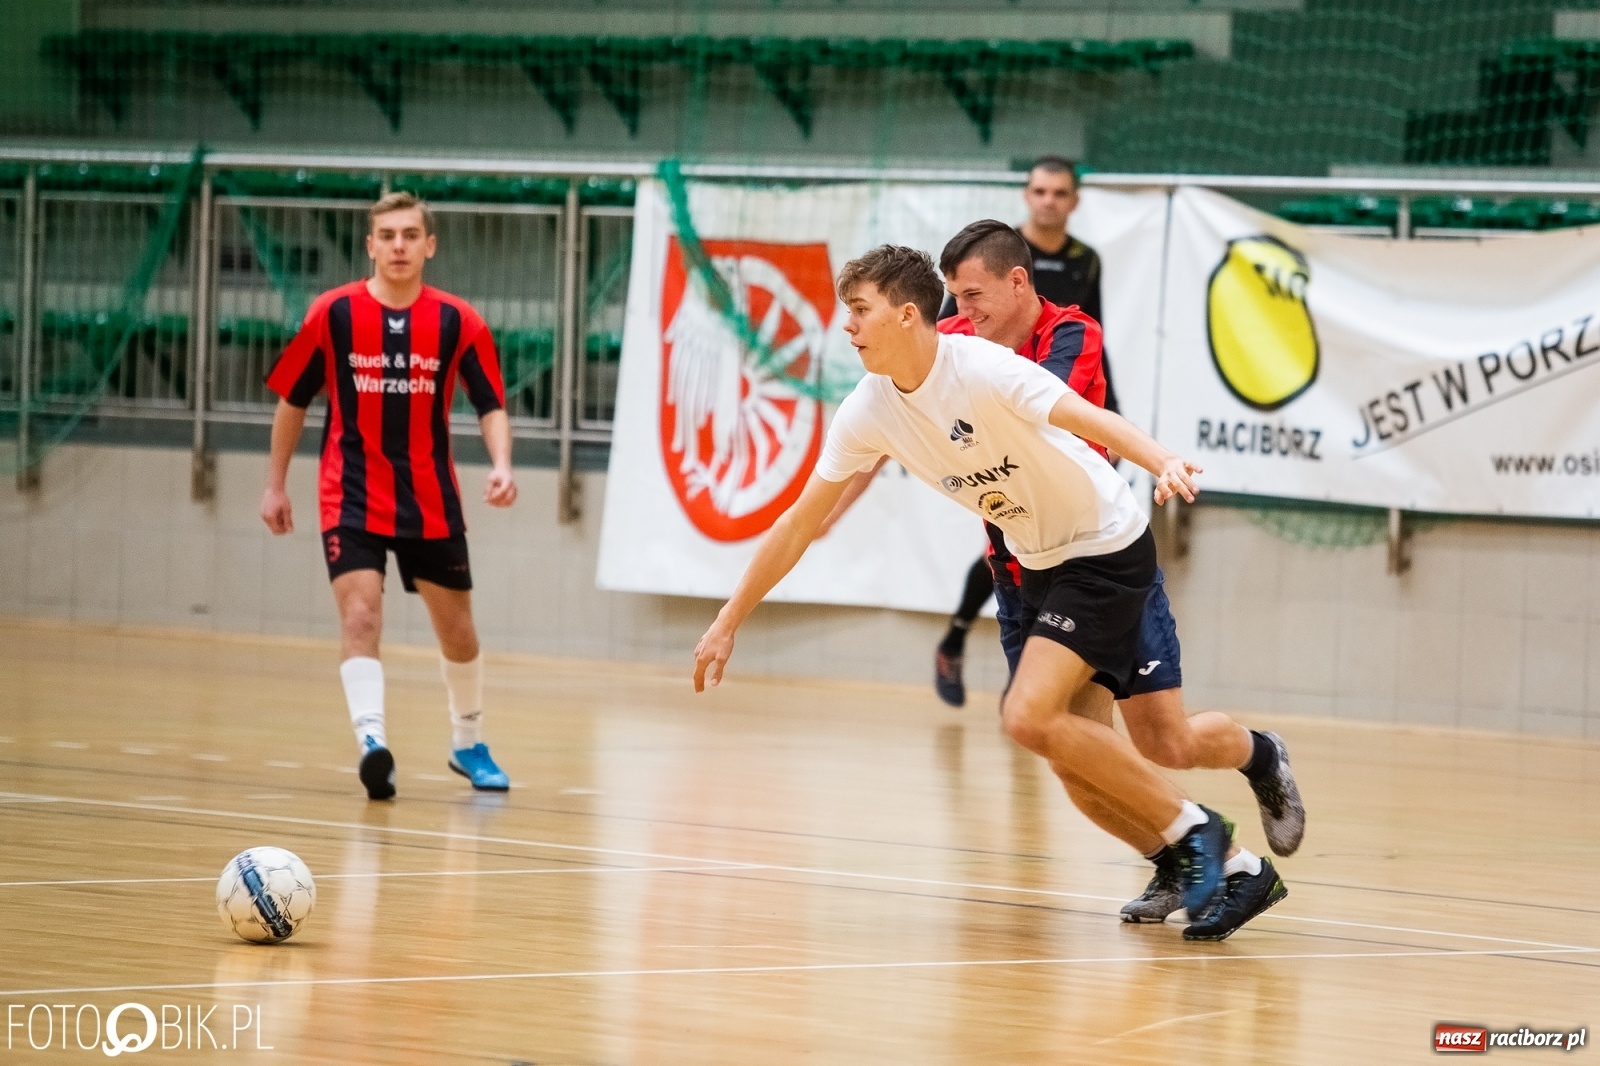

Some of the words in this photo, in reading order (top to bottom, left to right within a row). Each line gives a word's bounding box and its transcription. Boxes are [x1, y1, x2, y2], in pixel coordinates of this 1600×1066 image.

[348, 352, 390, 369] Stuck
[394, 353, 406, 369] &
[1352, 379, 1425, 448] JEST
[1430, 361, 1469, 412] W
[327, 534, 341, 563] 3
